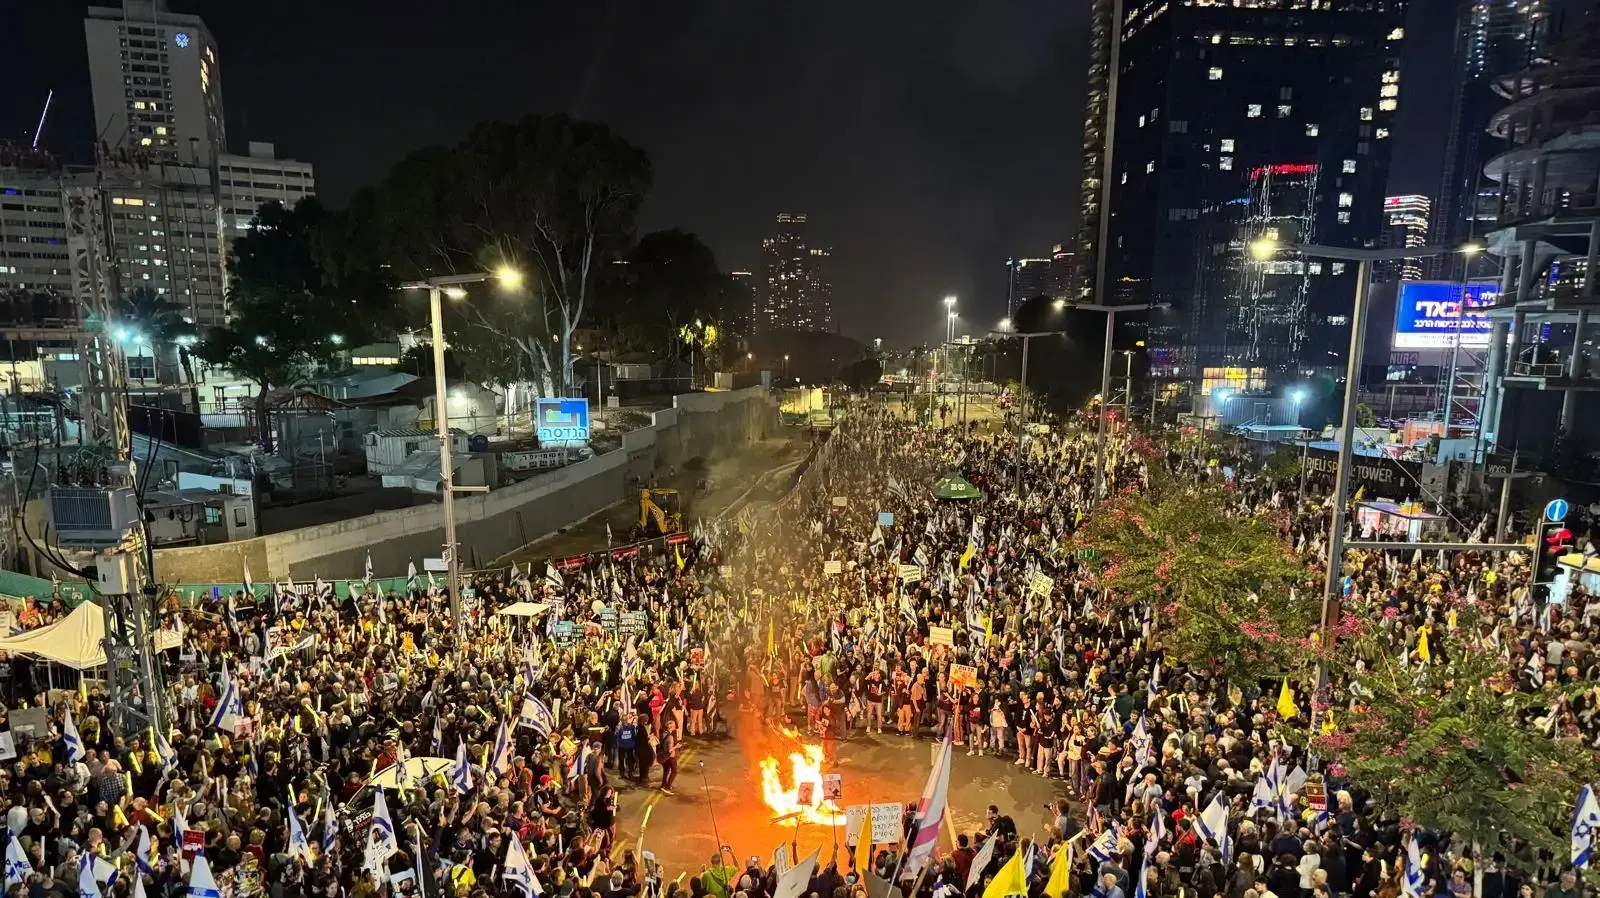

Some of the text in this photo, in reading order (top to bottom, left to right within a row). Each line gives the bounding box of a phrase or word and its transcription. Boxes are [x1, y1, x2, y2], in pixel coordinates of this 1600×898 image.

[1413, 320, 1433, 328] הרכב
[543, 427, 587, 438] הנדסה
[1356, 465, 1394, 482] TOWER
